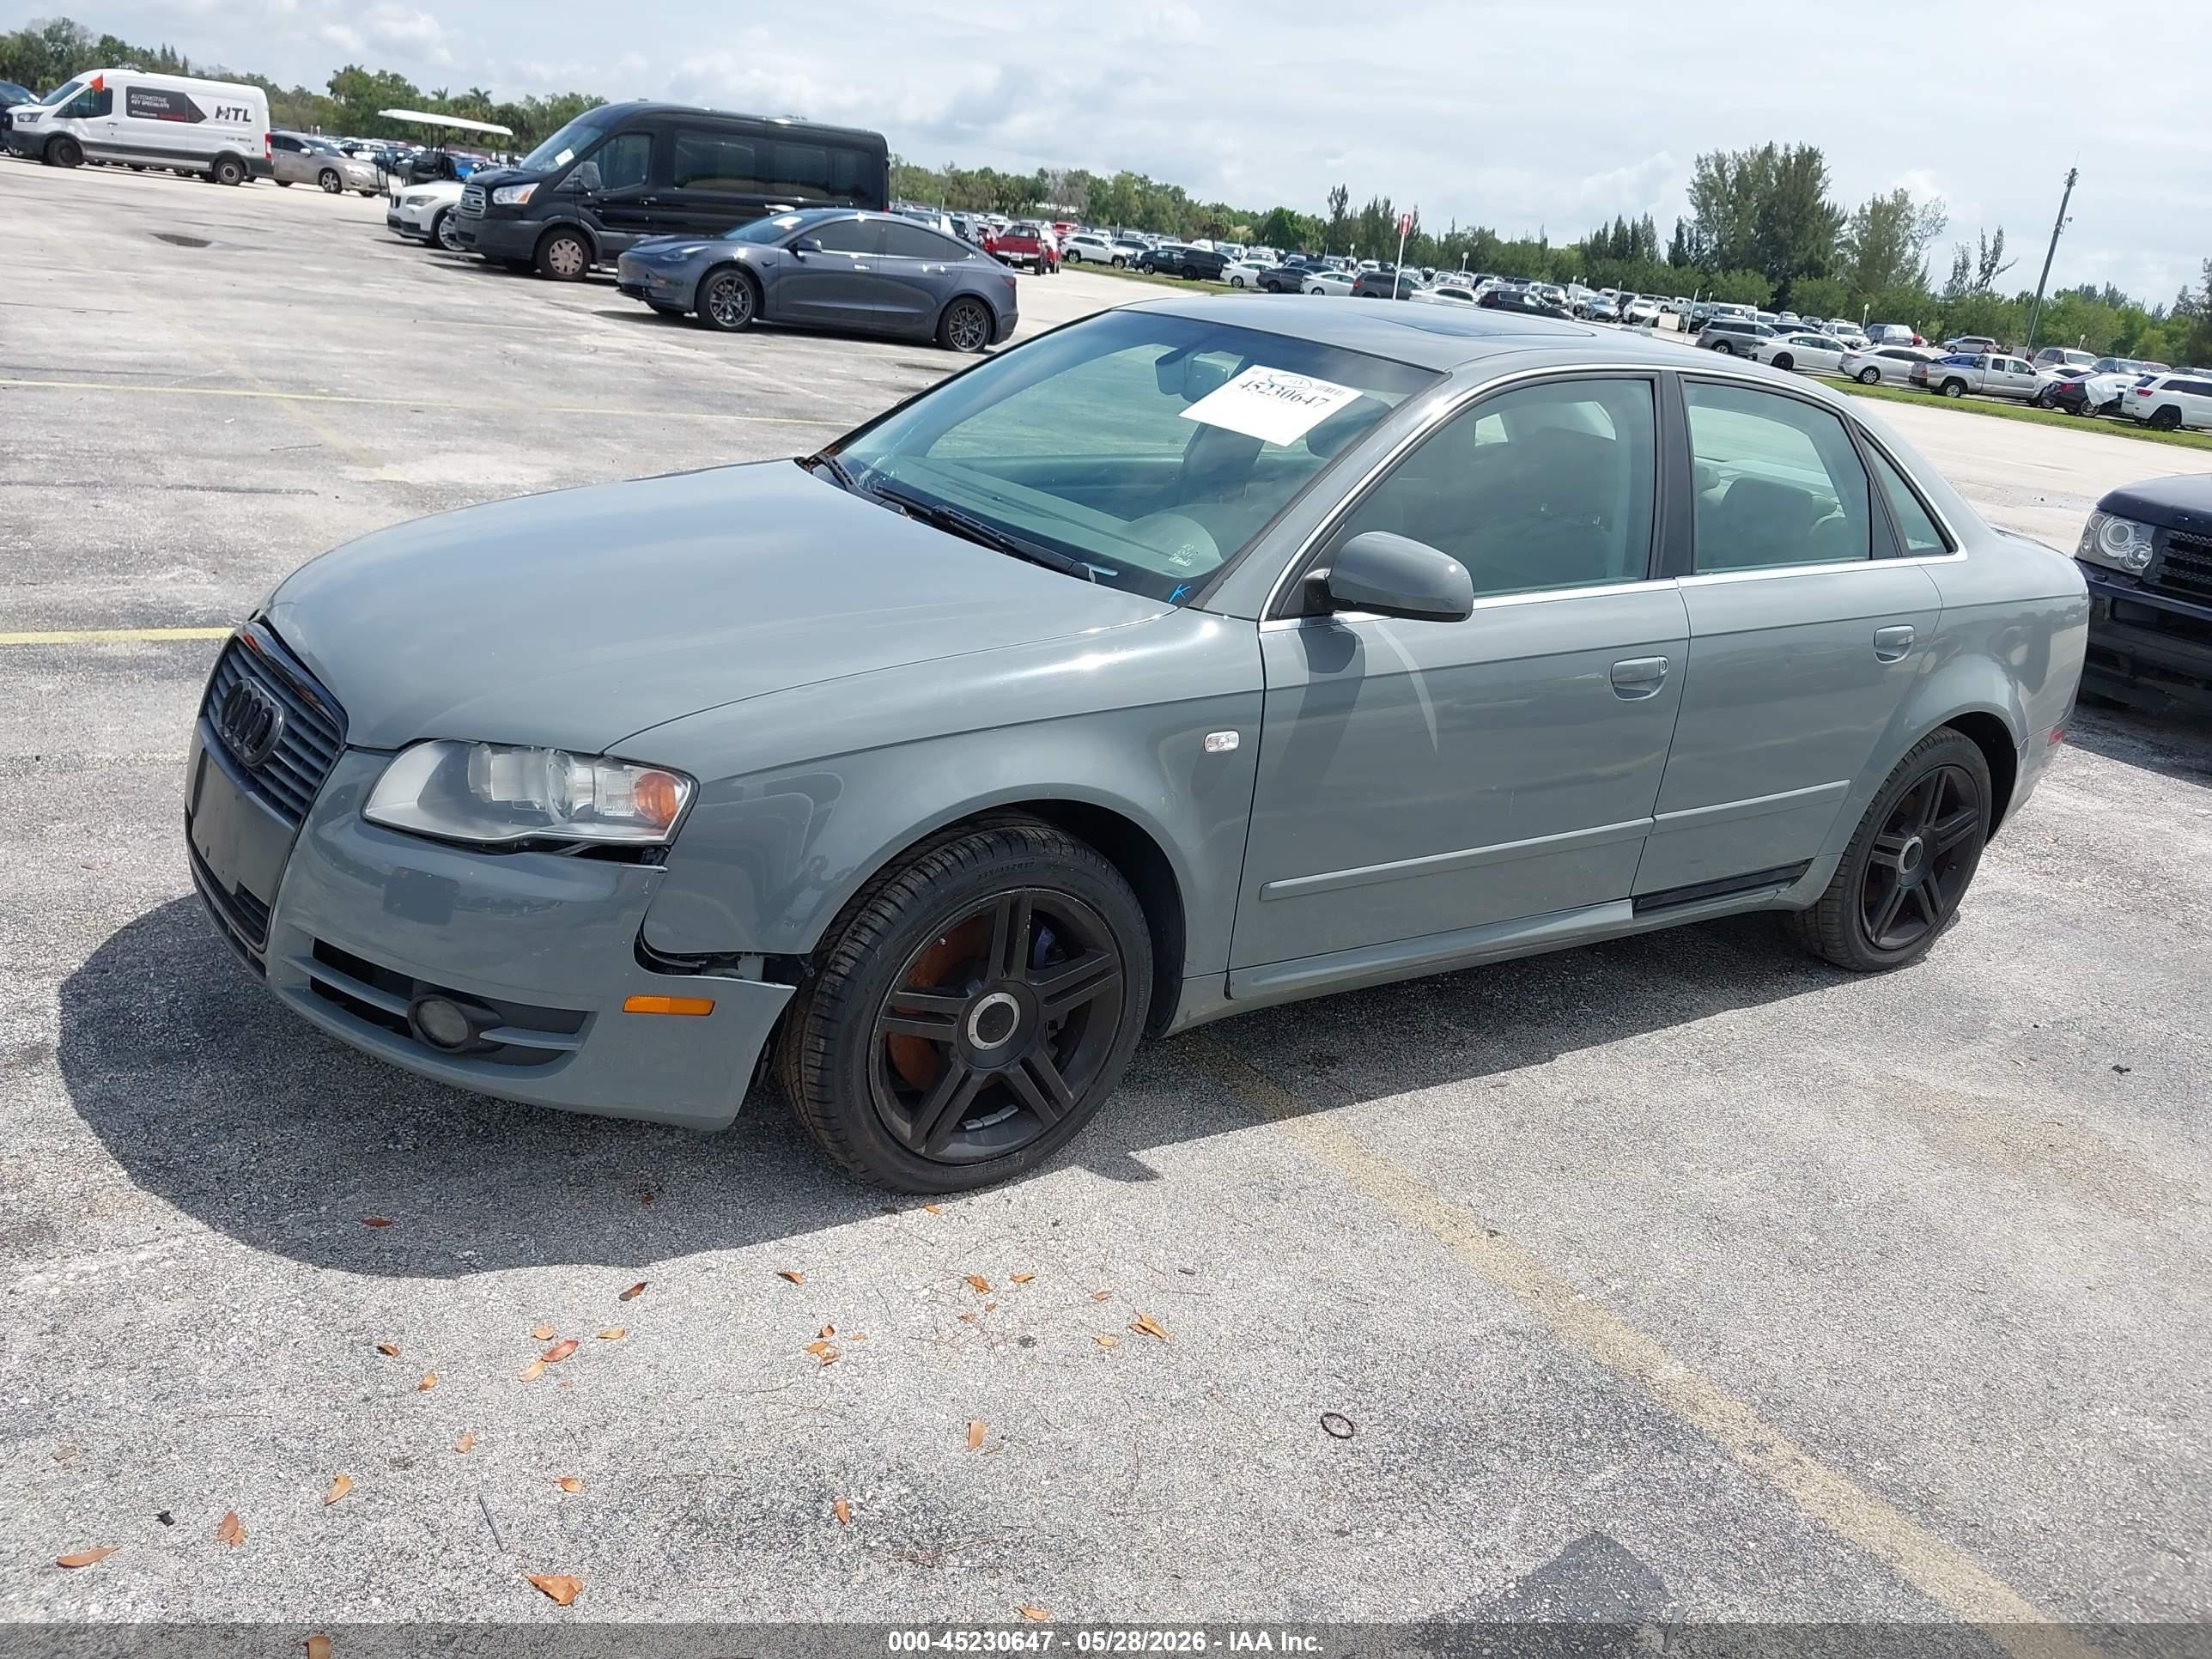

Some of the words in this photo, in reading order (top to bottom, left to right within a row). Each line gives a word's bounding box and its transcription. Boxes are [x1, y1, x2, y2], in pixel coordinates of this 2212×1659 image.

[131, 94, 167, 104] AUTOMOTIVE
[215, 106, 252, 122] HTL
[1239, 380, 1330, 408] 45230647
[1169, 583, 1192, 604] K
